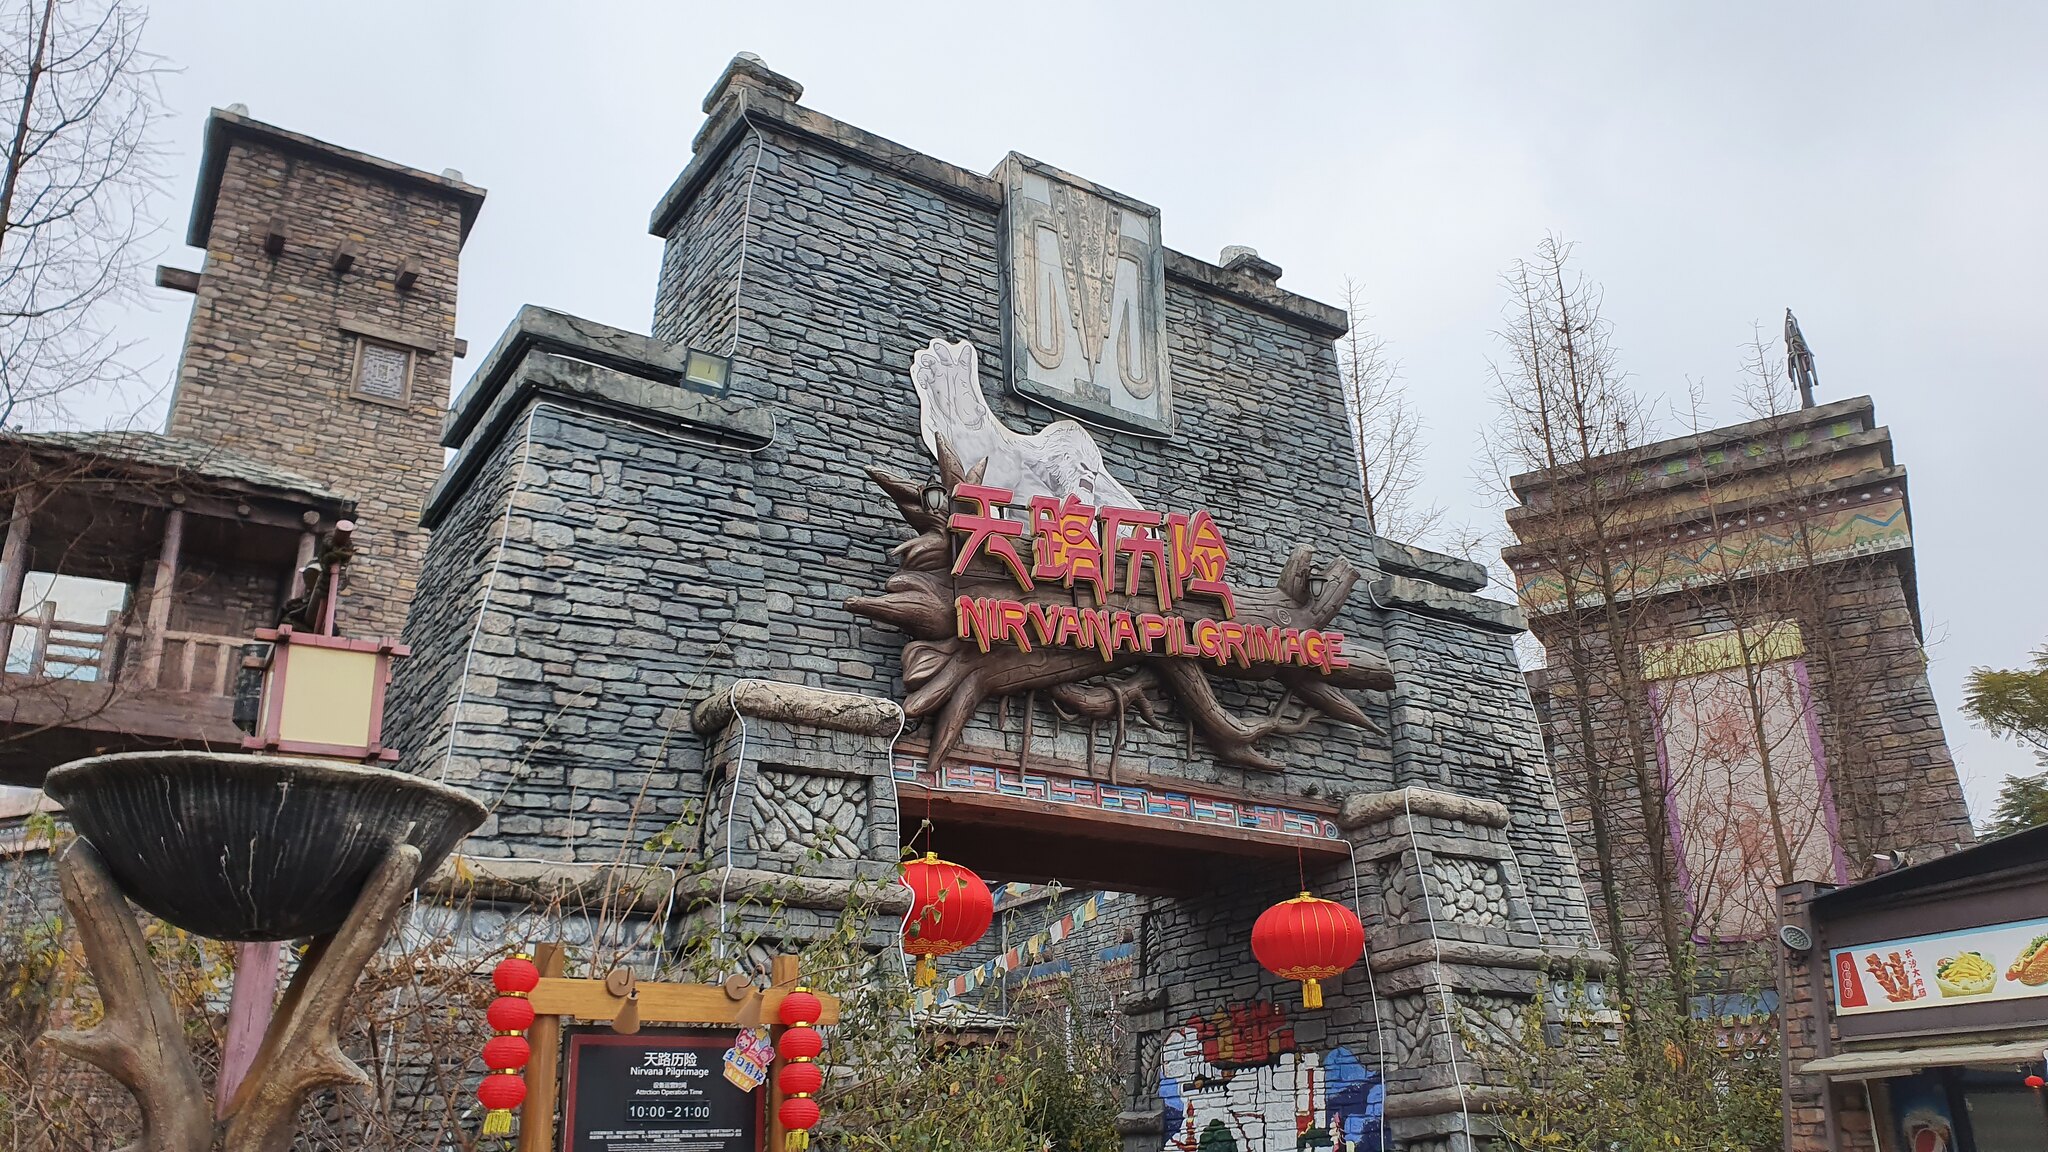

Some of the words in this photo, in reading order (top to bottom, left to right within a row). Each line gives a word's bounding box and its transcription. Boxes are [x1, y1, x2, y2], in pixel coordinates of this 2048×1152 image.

[947, 482, 1236, 618] 天路历险
[955, 595, 1141, 661] NIRVANA
[1137, 613, 1350, 674] PILGRIMAGE
[643, 1052, 698, 1067] 天路历险
[630, 1067, 663, 1076] Nirvana
[665, 1067, 709, 1078] Pilgrimage
[630, 1106, 710, 1118] 10:00-21:00
